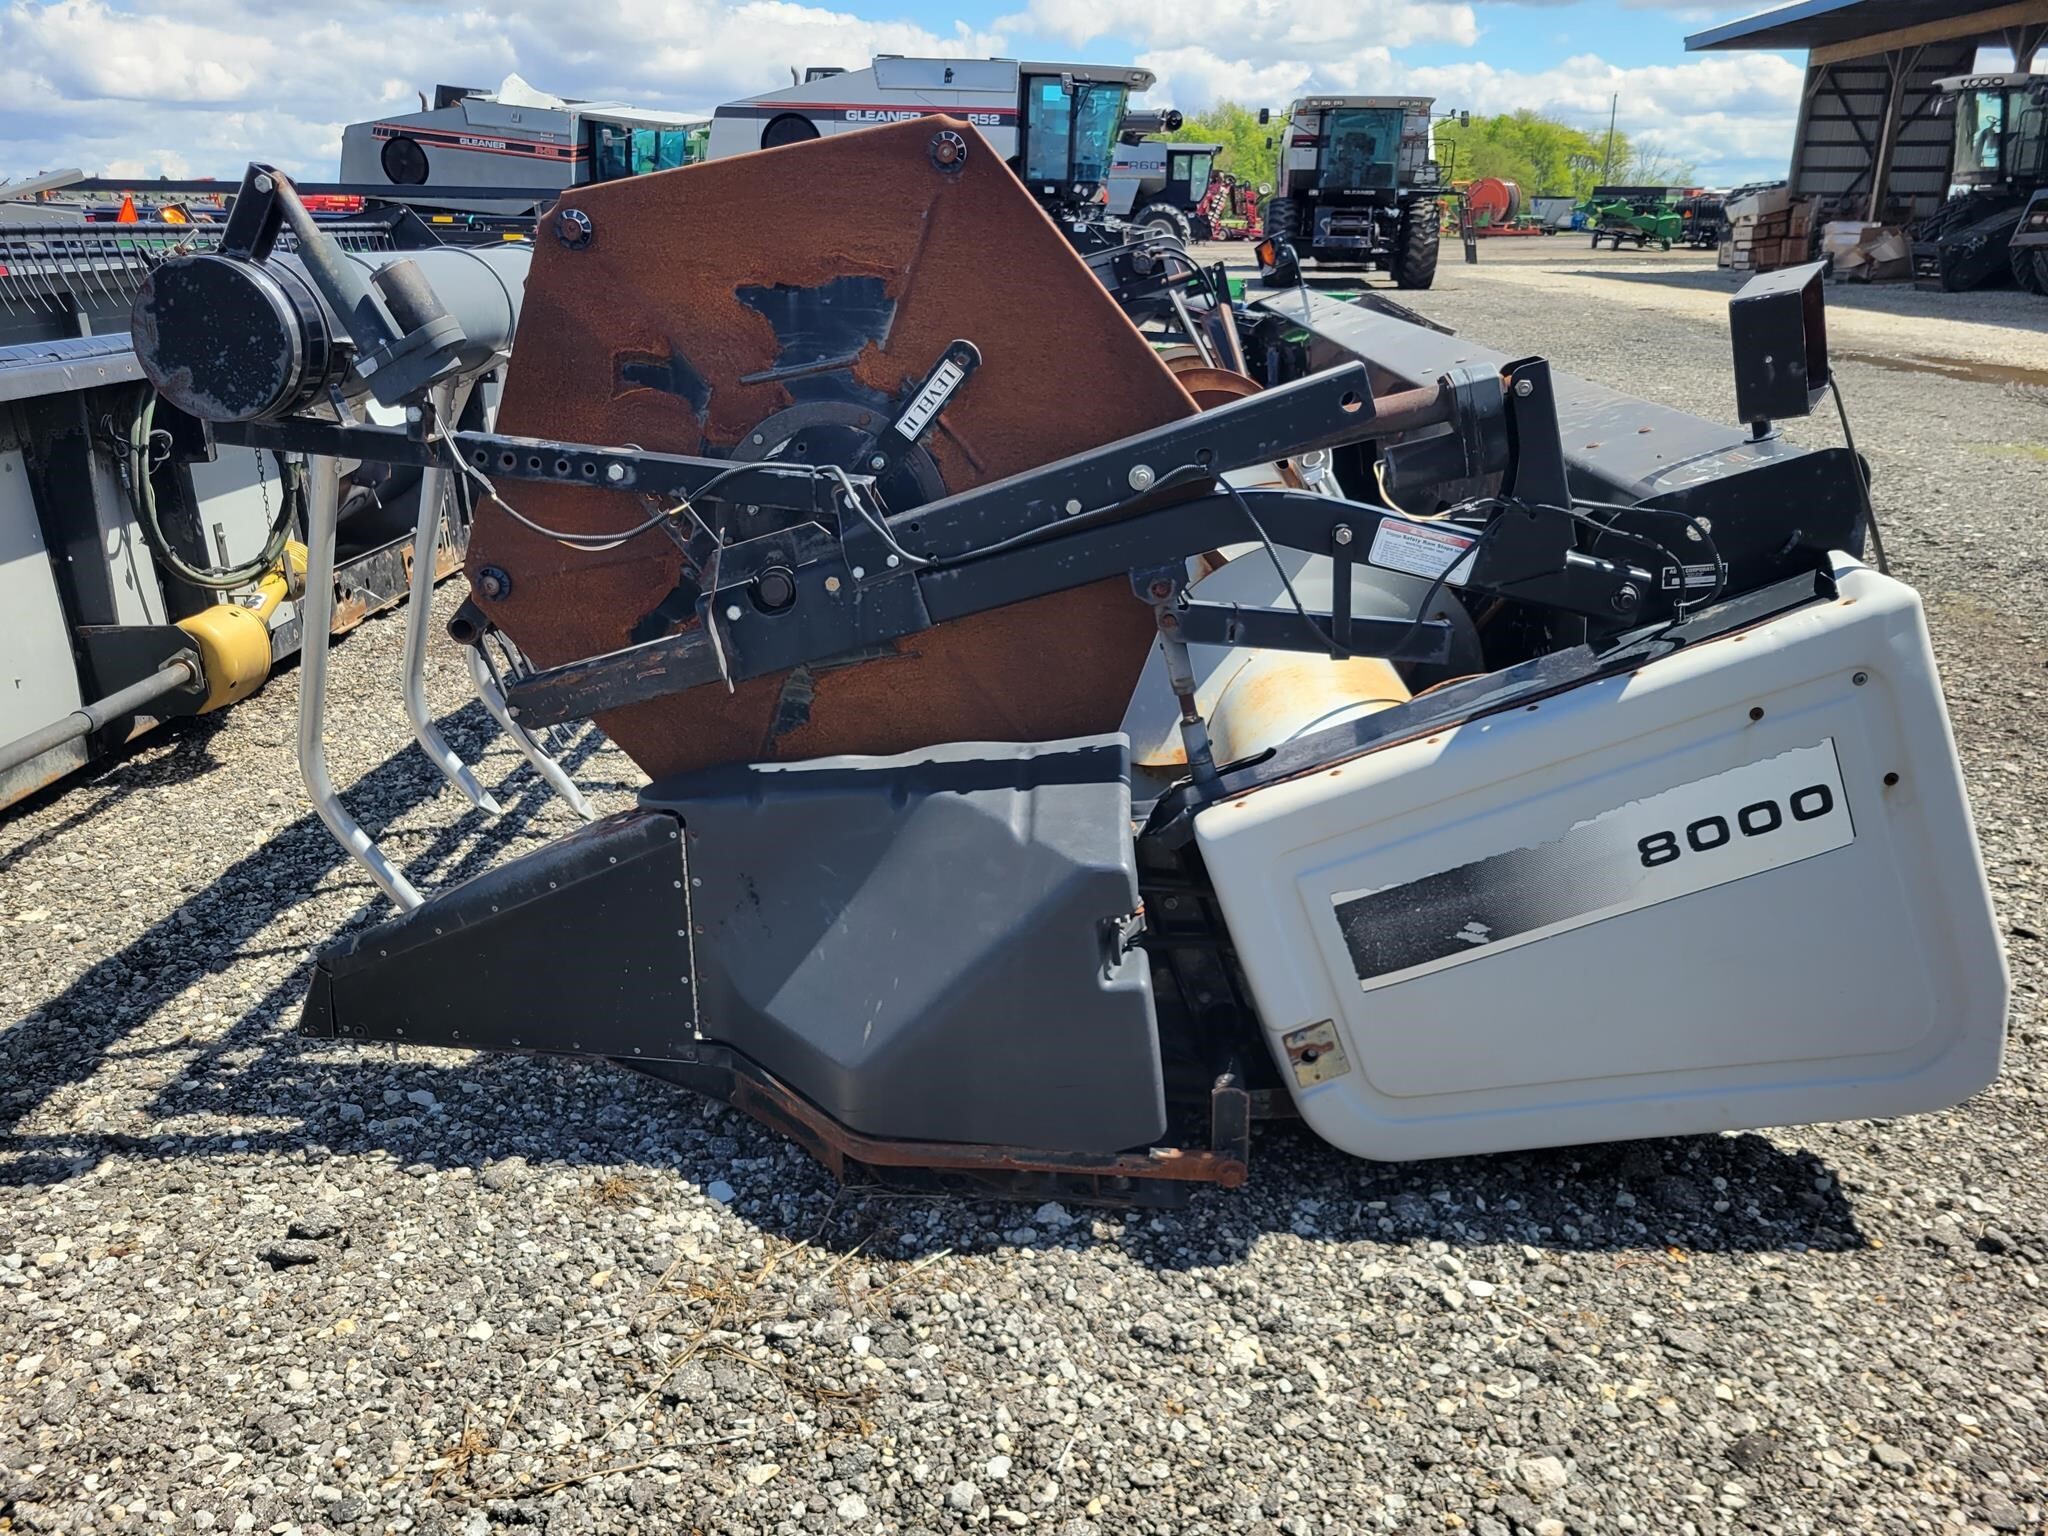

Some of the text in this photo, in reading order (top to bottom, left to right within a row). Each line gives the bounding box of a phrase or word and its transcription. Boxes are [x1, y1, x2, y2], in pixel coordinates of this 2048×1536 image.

[845, 109, 922, 122] GLEANER
[967, 113, 1001, 125] R52
[459, 137, 506, 150] GLEANER
[1129, 160, 1159, 170] R60
[913, 369, 956, 415] LEVEL
[1402, 534, 1421, 544] Safety
[1437, 543, 1454, 552] Stops
[1637, 783, 1834, 868] 8000
